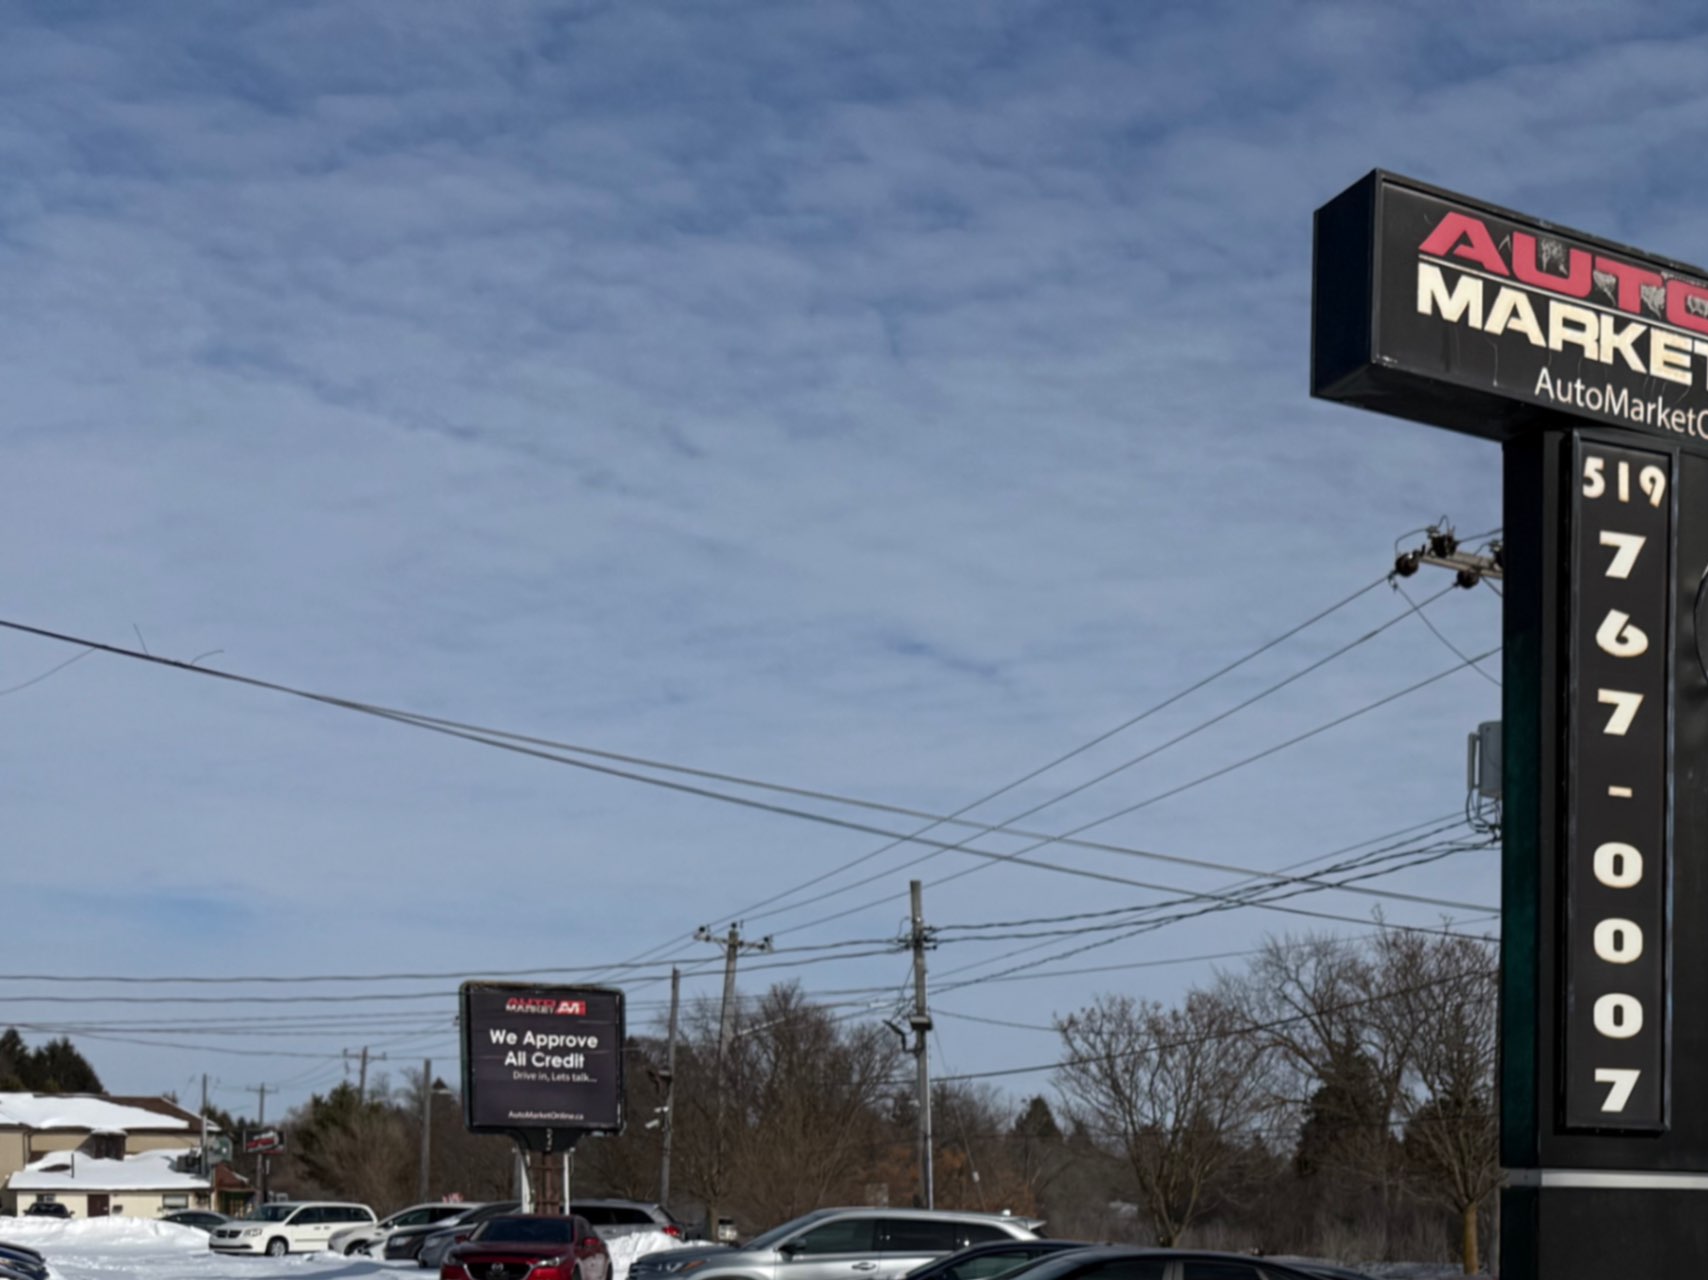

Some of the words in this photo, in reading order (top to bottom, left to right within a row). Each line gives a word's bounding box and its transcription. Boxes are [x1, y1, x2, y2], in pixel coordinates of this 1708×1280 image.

[1582, 455, 1667, 508] 519
[489, 1028, 518, 1045] We
[522, 1030, 598, 1049] Approve
[504, 1051, 527, 1067] All
[531, 1052, 584, 1069] Credit
[513, 1070, 537, 1081] Drive
[551, 1072, 571, 1082] Lets
[508, 1110, 584, 1121] AutoMarketOnline.ca
